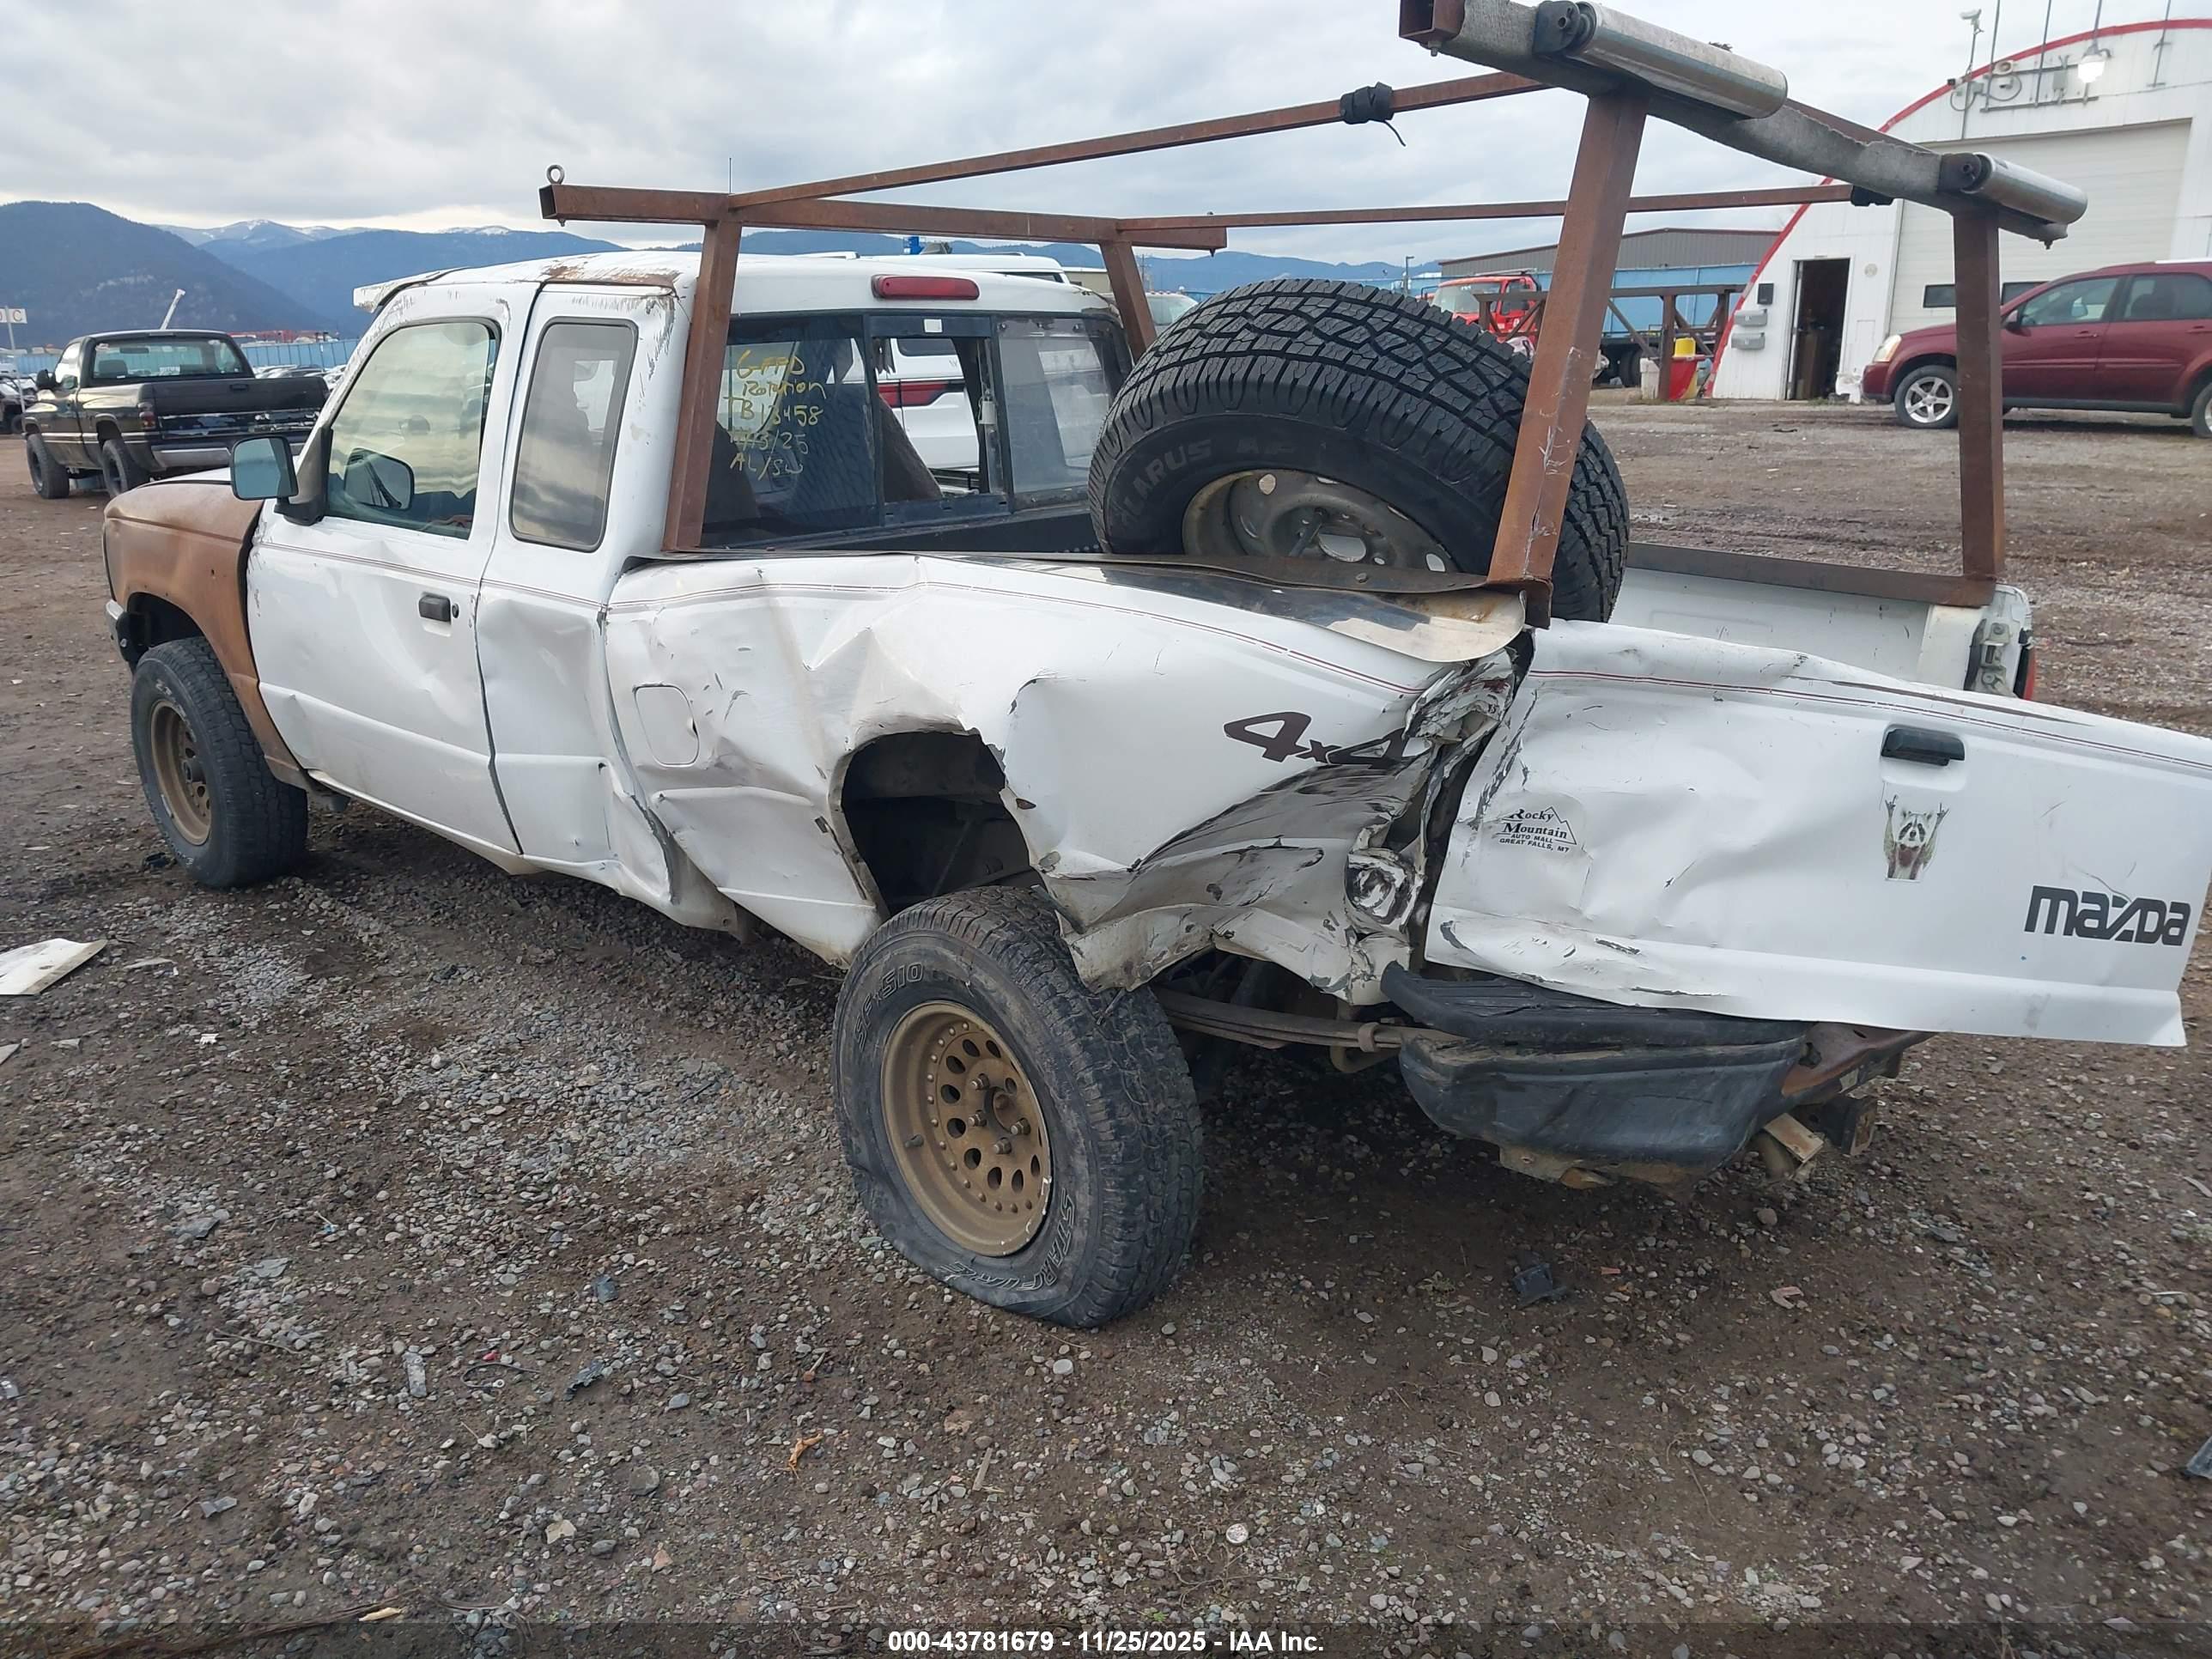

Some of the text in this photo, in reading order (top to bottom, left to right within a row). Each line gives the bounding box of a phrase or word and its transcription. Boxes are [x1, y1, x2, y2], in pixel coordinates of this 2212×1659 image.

[1504, 809, 1554, 823] Rocky
[1502, 823, 1567, 839] Mountain
[1527, 840, 1553, 850] FALLS,
[1534, 835, 1553, 843] MALL
